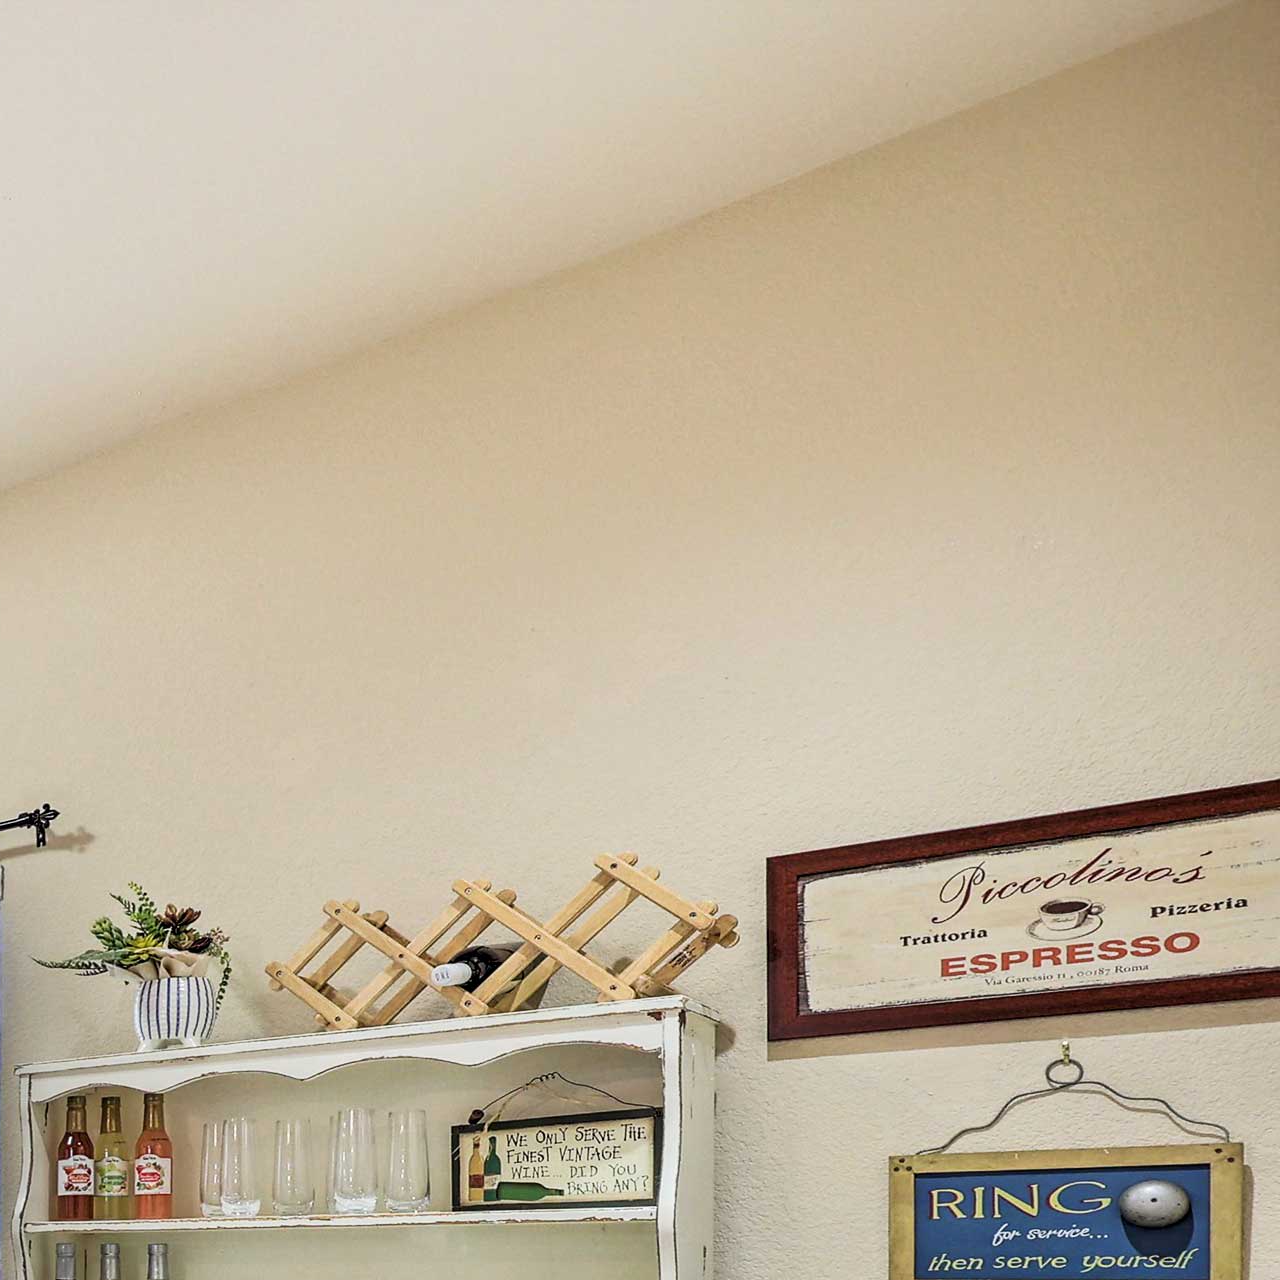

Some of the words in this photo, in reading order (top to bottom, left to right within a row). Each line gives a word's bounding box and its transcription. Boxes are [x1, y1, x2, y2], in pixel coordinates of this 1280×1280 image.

[899, 926, 988, 947] Trattoria
[1150, 897, 1249, 919] Pizzeria
[940, 931, 1201, 978] ESPRESSO
[984, 975, 1002, 987] Via
[1114, 964, 1150, 976] Roma
[506, 1132, 528, 1148] WE
[535, 1127, 570, 1145] ONLY
[575, 1125, 616, 1142] SERVE
[621, 1122, 648, 1142] THE
[506, 1146, 553, 1164] FINEST
[559, 1145, 622, 1163] VINTAGE
[570, 1165, 598, 1178] DID
[608, 1163, 637, 1177] YOU
[567, 1181, 608, 1196] BRING
[612, 1175, 649, 1193] ANY?
[928, 1180, 1113, 1221] RING
[992, 1223, 1021, 1247] for
[1026, 1223, 1109, 1241] service...
[928, 1253, 984, 1272] then
[993, 1253, 1067, 1270] serve
[1080, 1248, 1199, 1274] yourself
